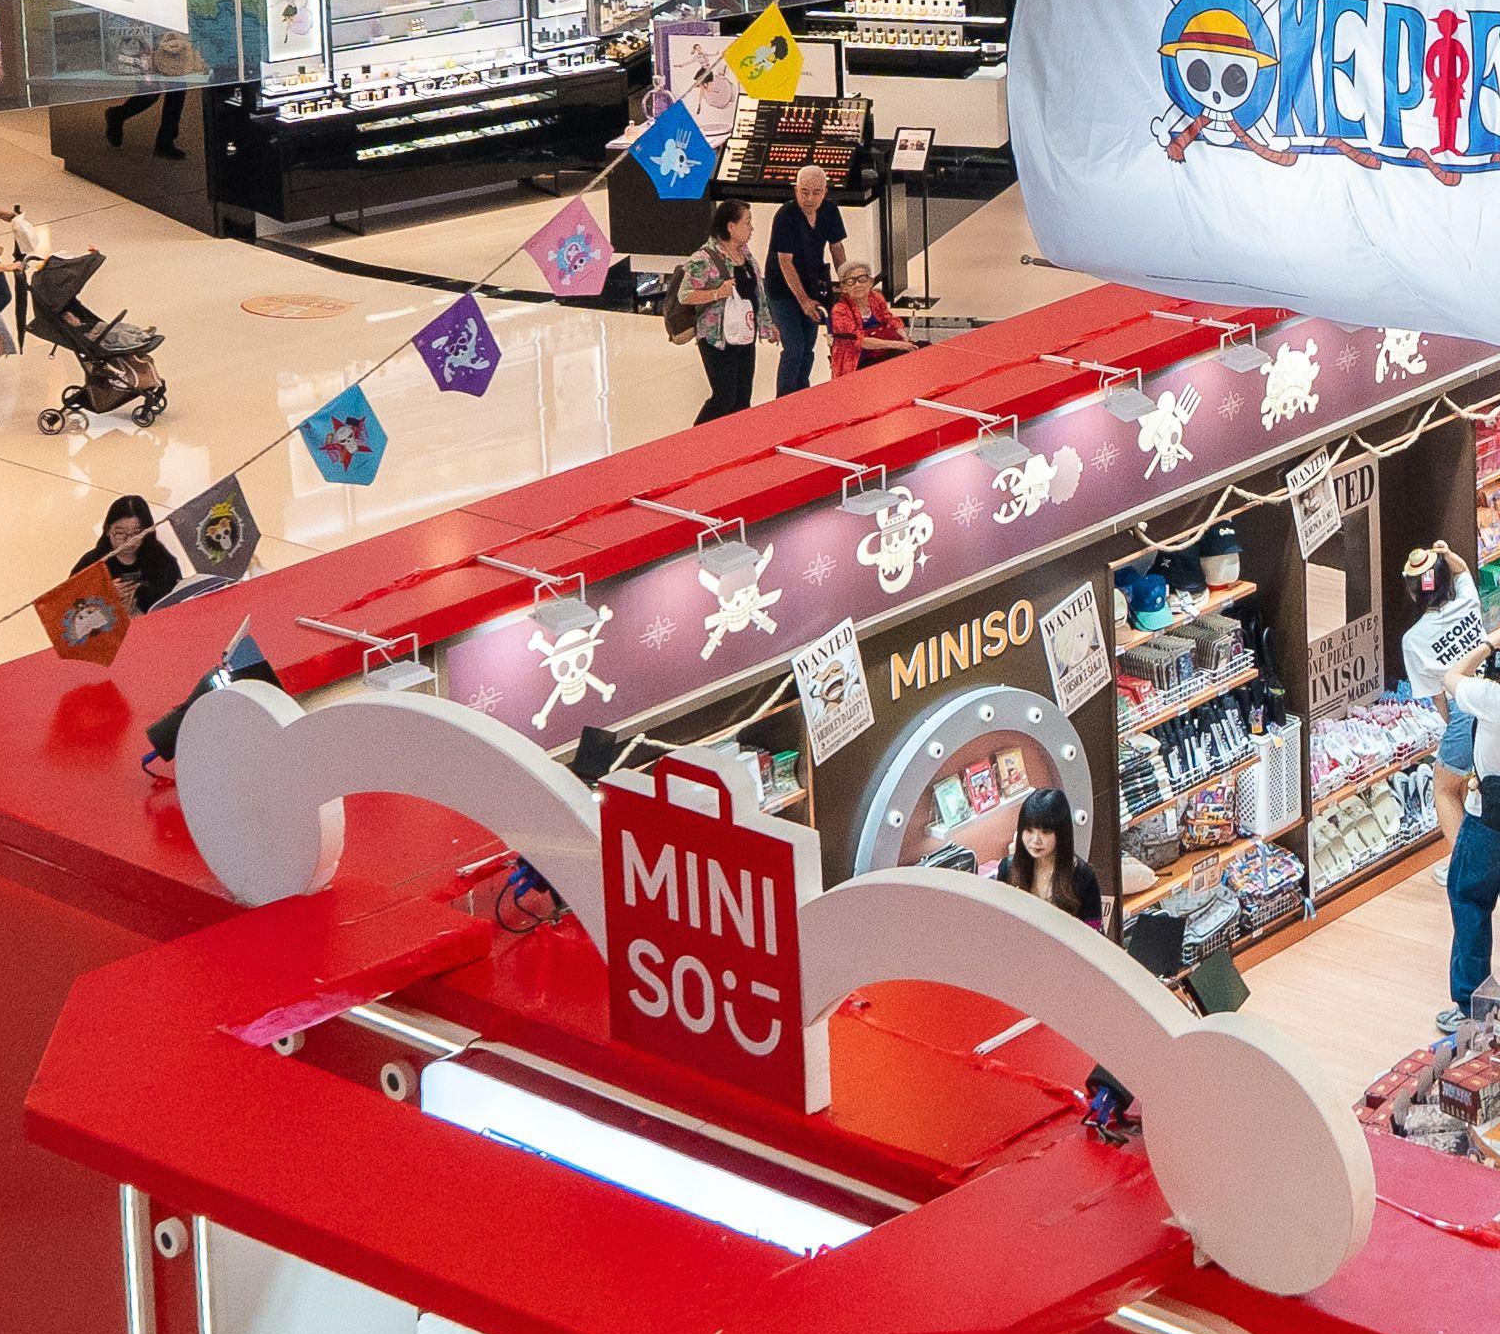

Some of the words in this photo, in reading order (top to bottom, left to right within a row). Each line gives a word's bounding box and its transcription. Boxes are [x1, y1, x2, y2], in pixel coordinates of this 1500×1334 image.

[1289, 450, 1328, 489] WANTED
[1043, 589, 1094, 638] WANTED
[1320, 636, 1334, 653] OR
[1341, 618, 1374, 646] ALIVE
[1431, 610, 1478, 655] BECOME
[797, 625, 854, 676] WANTED
[891, 598, 1035, 701] MINISO
[1326, 640, 1355, 667] PIECE
[1436, 645, 1459, 667] THE
[1455, 619, 1484, 654] NEXT
[1311, 654, 1366, 705] INISO
[1347, 674, 1381, 704] MARINE
[621, 829, 779, 956] MINI
